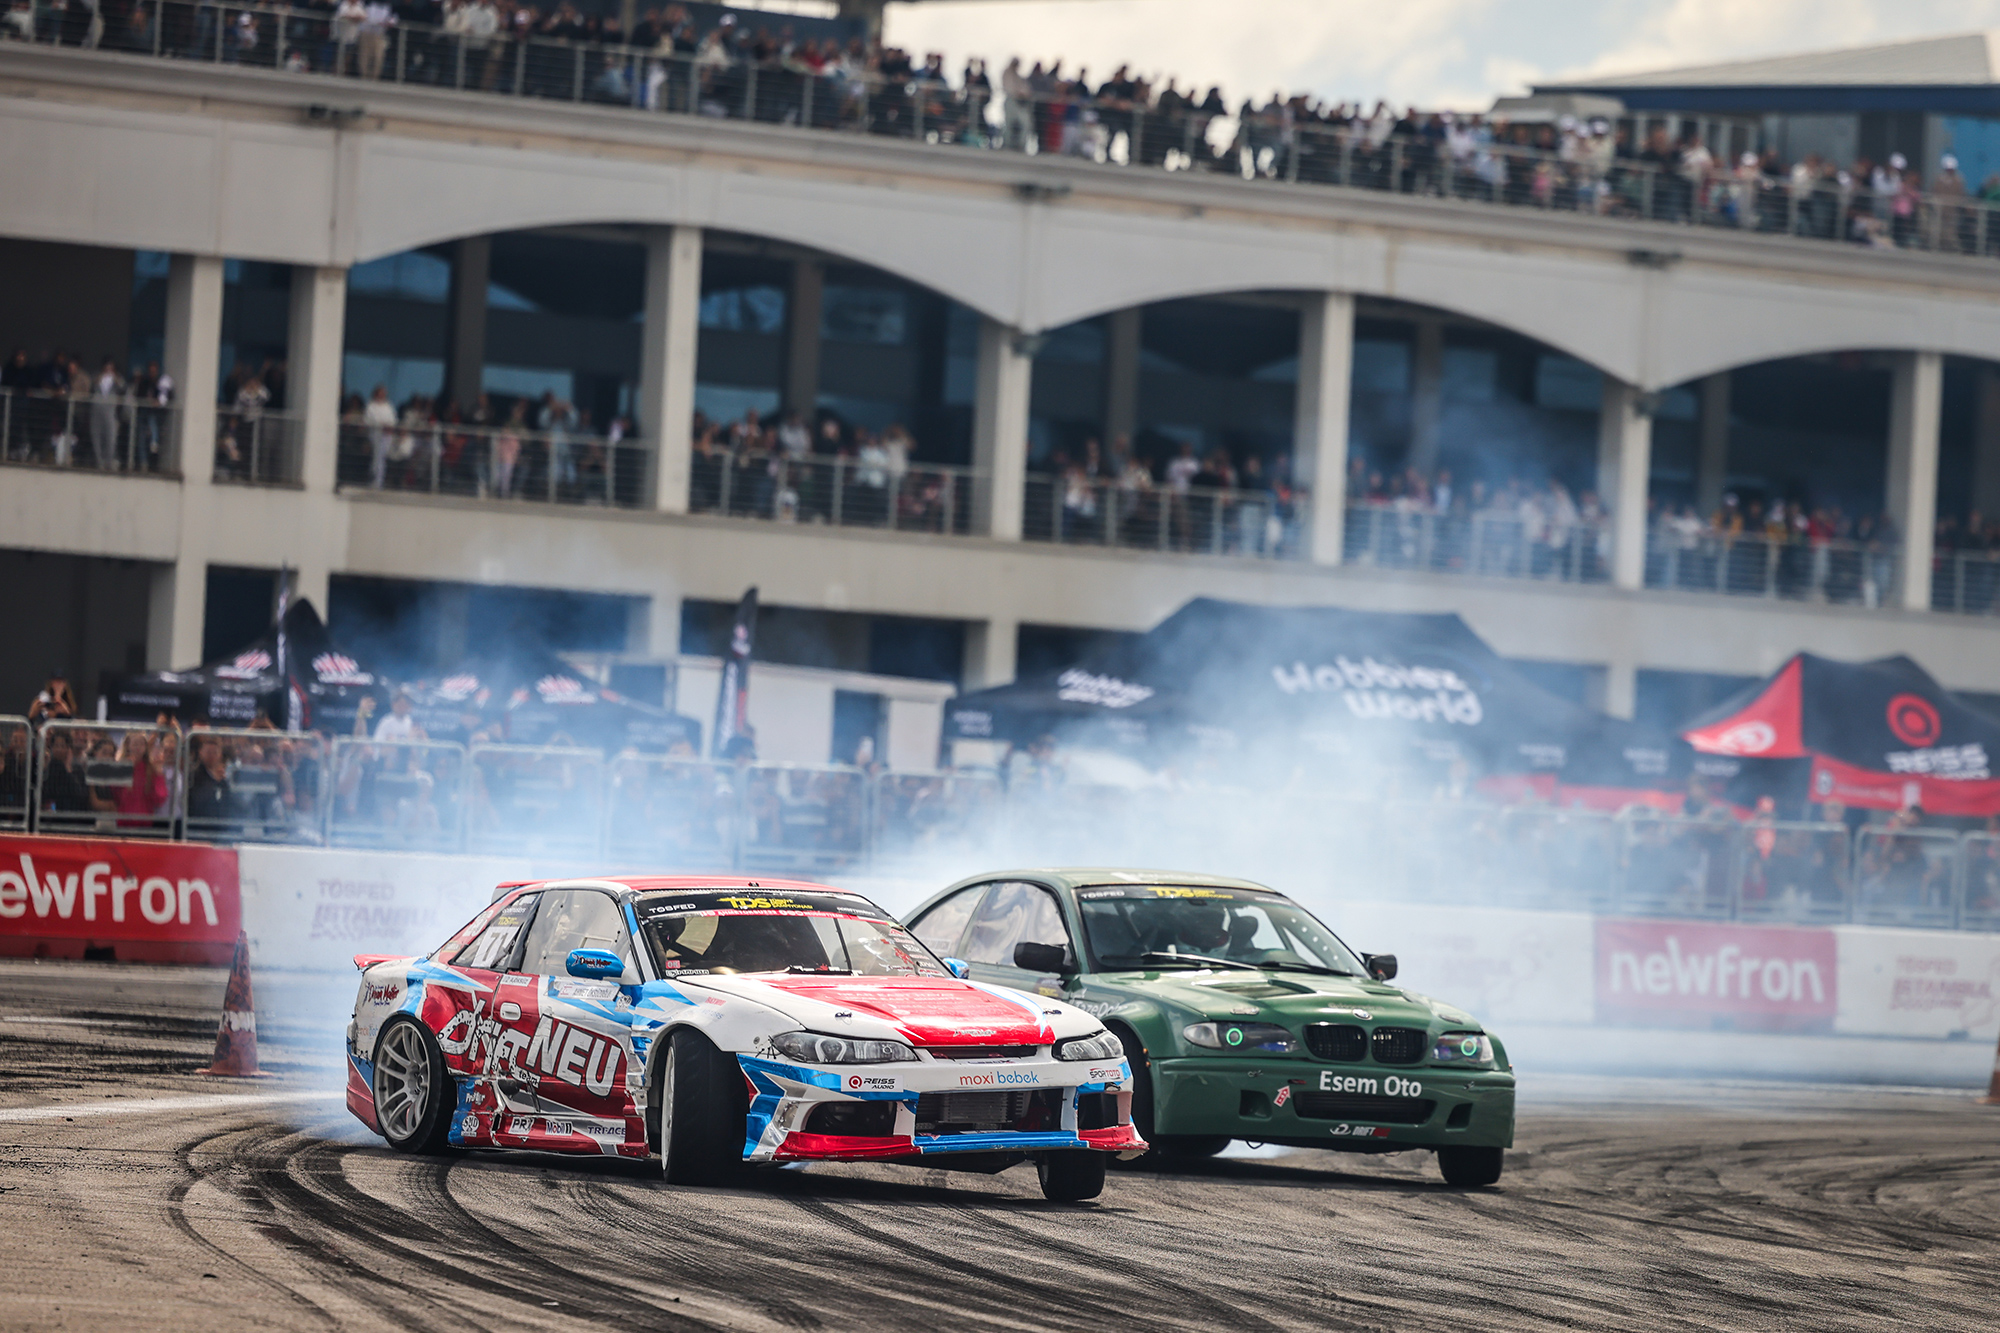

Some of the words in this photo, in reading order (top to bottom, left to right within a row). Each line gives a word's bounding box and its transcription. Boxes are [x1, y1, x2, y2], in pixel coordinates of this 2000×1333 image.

[1342, 689, 1482, 725] World
[0, 852, 218, 925] ewfron
[1081, 890, 1125, 899] TOSFED
[648, 903, 697, 913] TOSFED
[716, 897, 771, 909] TDS
[1610, 936, 1824, 1002] newfron
[525, 1013, 622, 1097] NEU
[863, 1077, 896, 1085] REISS
[959, 1072, 994, 1085] moxi
[997, 1070, 1039, 1084] bebek
[1319, 1070, 1378, 1095] Esem
[1384, 1075, 1422, 1097] Oto
[547, 1121, 565, 1133] Mobil
